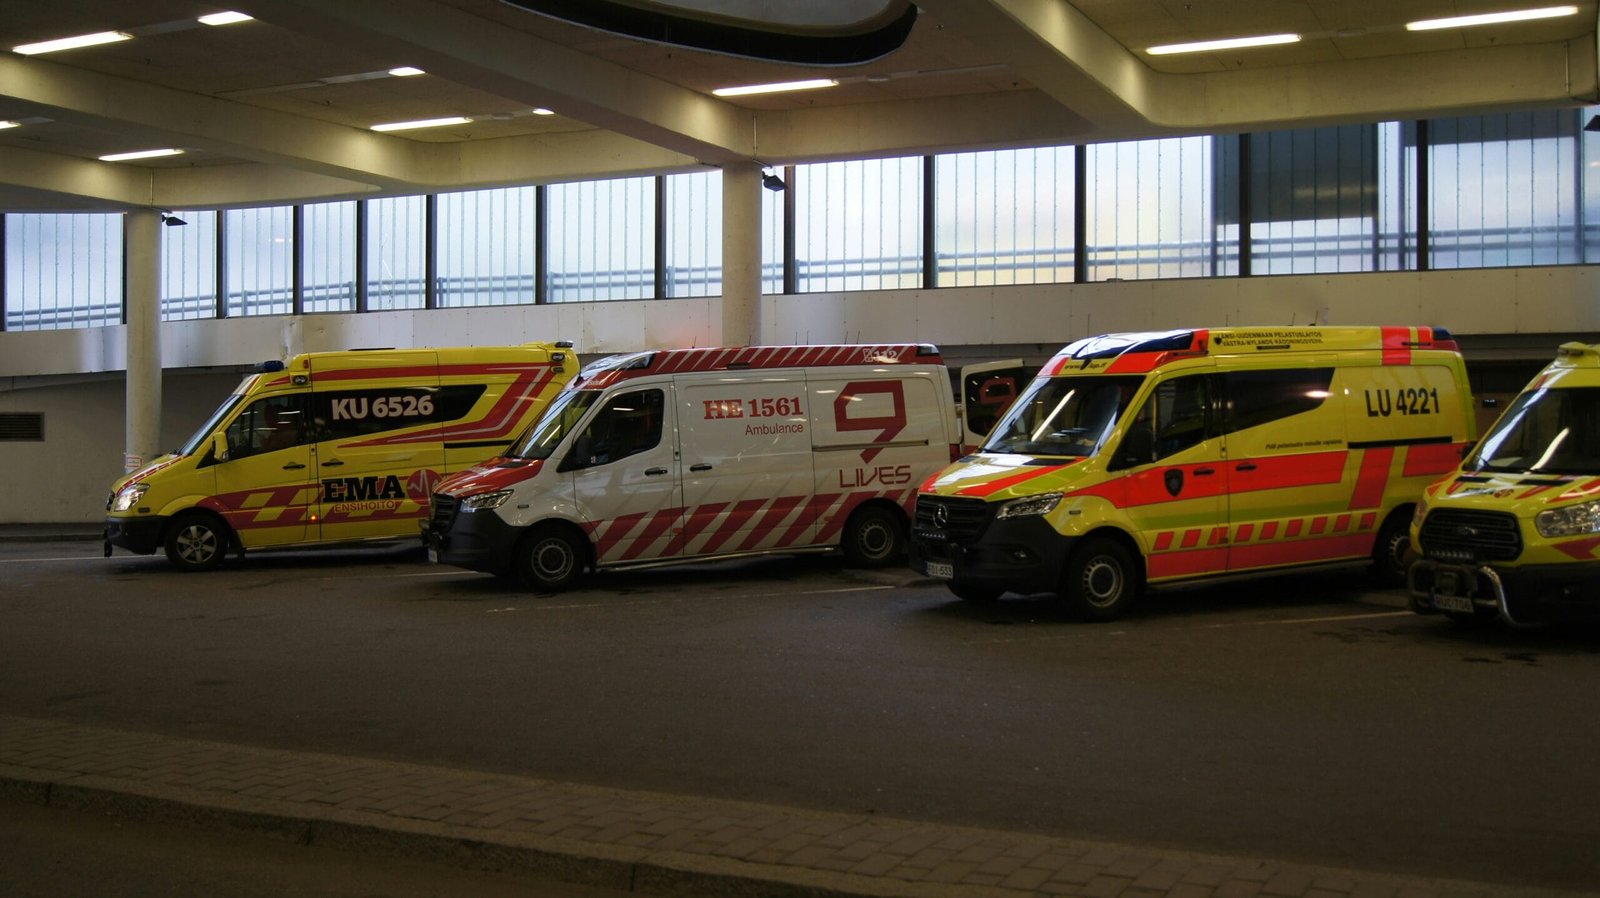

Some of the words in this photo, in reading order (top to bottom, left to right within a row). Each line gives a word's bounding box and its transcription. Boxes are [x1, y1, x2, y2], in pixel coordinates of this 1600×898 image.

[331, 398, 368, 421] KU
[372, 394, 435, 419] 6526
[703, 399, 743, 420] HE
[748, 397, 804, 417] 1561
[1365, 389, 1392, 418] LU
[1396, 387, 1439, 416] 4221
[745, 424, 804, 436] Ambulance
[834, 380, 907, 464] 9
[322, 475, 405, 502] EMA
[840, 465, 911, 488] LIVES
[334, 500, 395, 513] ENSIHOITO
